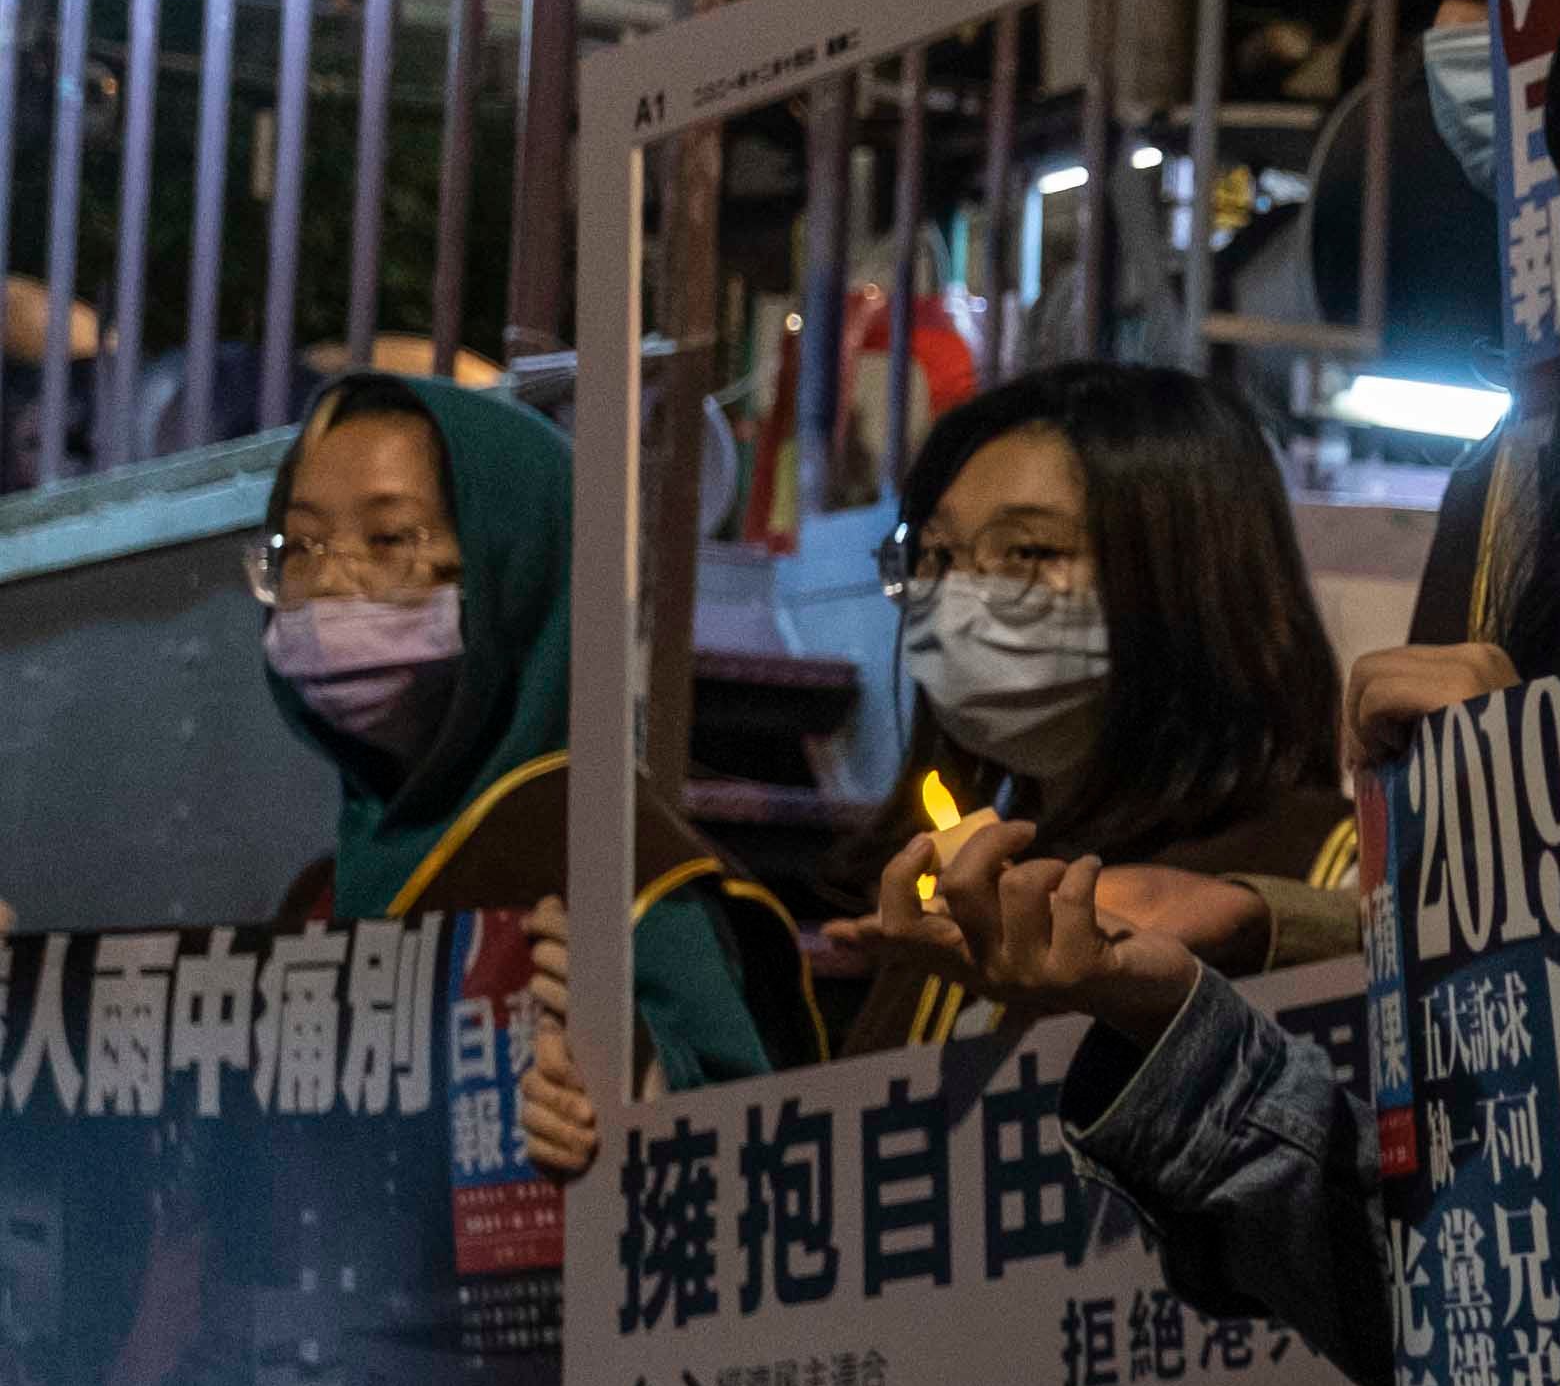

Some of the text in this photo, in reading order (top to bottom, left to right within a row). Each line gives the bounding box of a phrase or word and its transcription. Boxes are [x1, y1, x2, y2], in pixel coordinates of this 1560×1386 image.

[0, 911, 445, 1116] 人雨中痛別
[616, 1051, 1165, 1337] 擁抱自由
